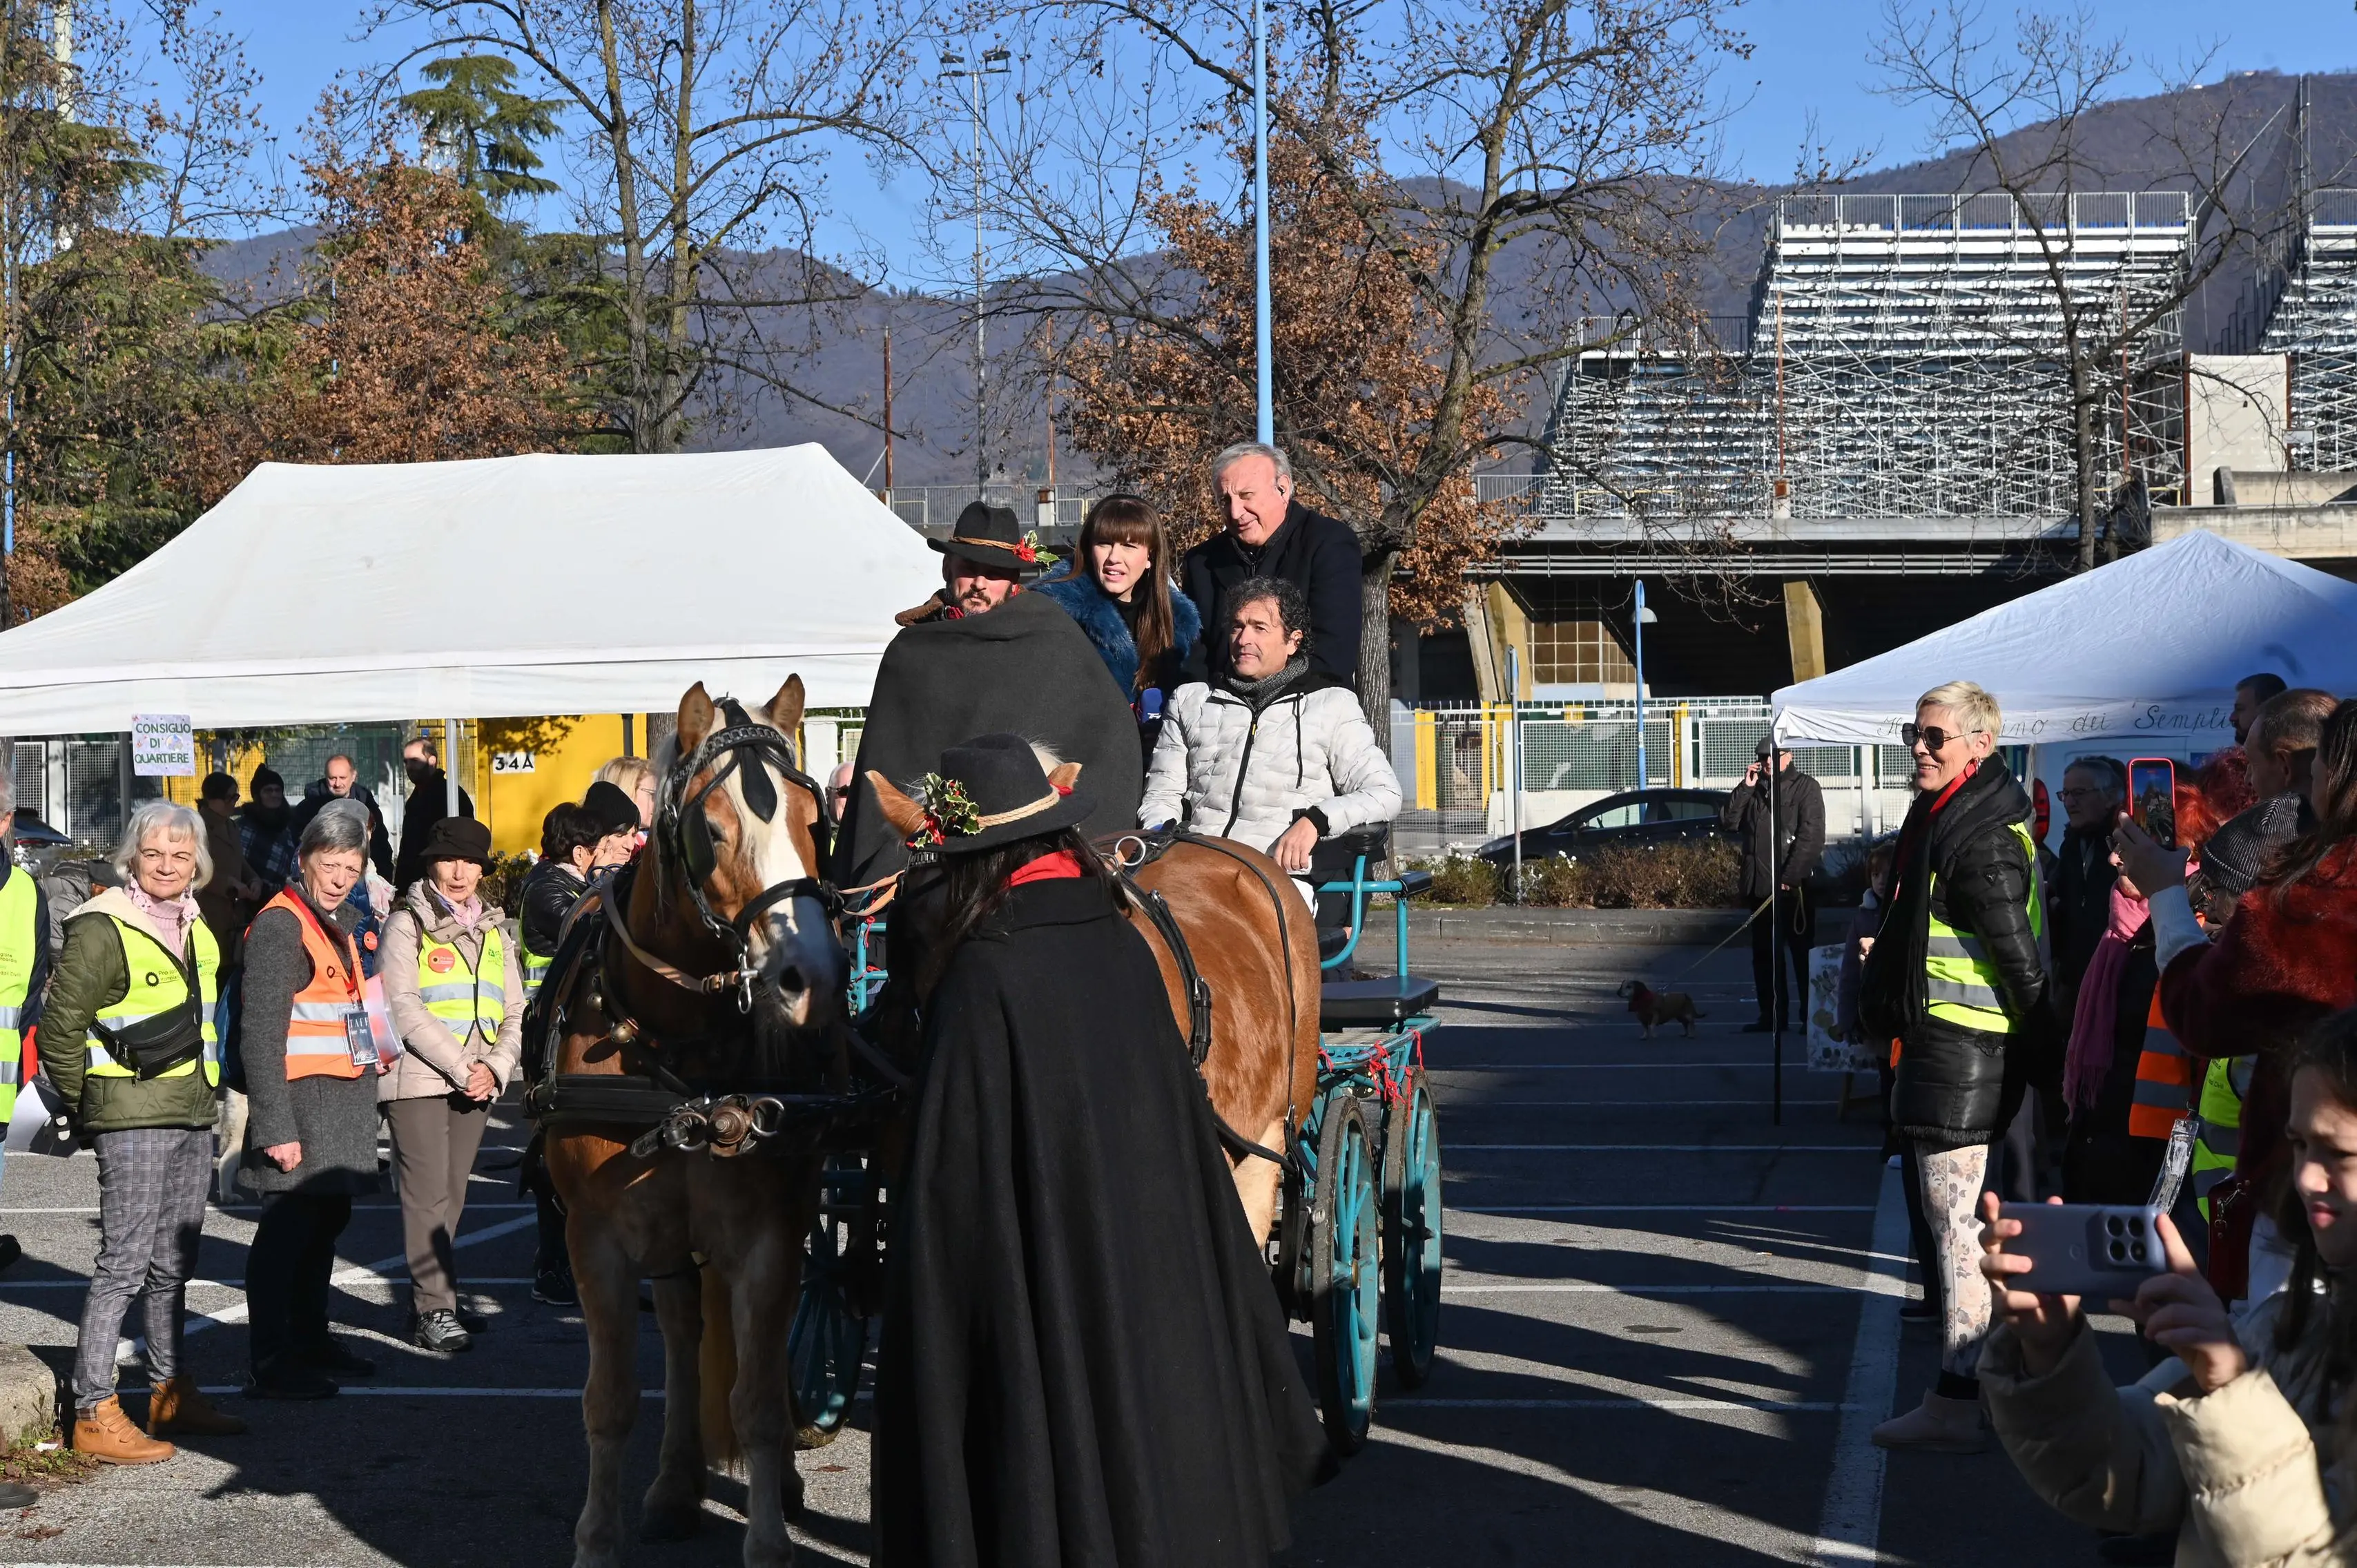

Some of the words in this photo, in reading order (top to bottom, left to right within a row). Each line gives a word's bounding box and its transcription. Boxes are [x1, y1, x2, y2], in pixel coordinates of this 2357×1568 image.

[2069, 712, 2108, 732] dei
[2134, 705, 2233, 735] Sempli
[135, 723, 191, 734] CONSIGLIO
[150, 737, 160, 748] DI
[135, 753, 190, 764] QUARTIERE
[495, 755, 534, 771] 34A
[349, 1017, 369, 1028] TAFF
